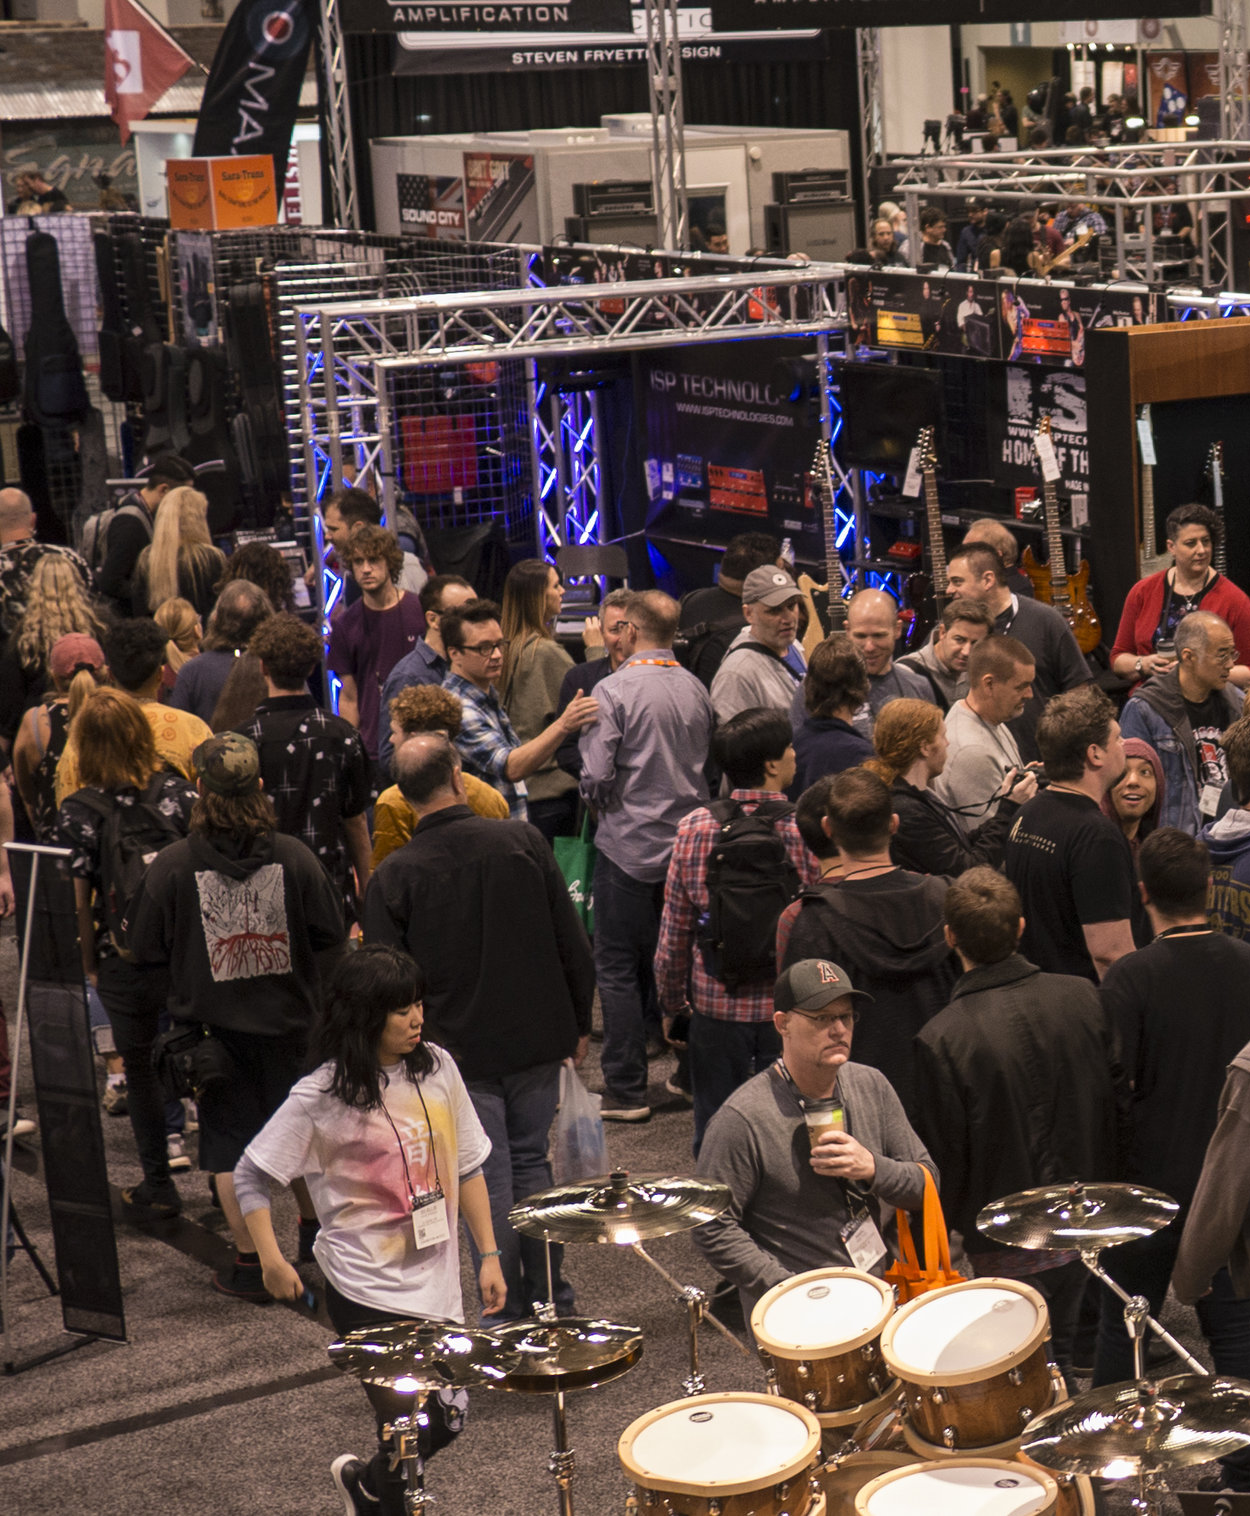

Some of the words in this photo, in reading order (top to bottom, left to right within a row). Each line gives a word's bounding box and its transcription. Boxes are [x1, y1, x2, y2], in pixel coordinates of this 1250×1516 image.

[393, 6, 569, 22] AMPLIFICATION
[511, 50, 579, 65] STEVEN
[230, 61, 275, 157] MA
[402, 207, 437, 224] SOUND
[437, 210, 462, 226] CITY
[651, 369, 677, 393] ISP
[816, 960, 840, 985] A
